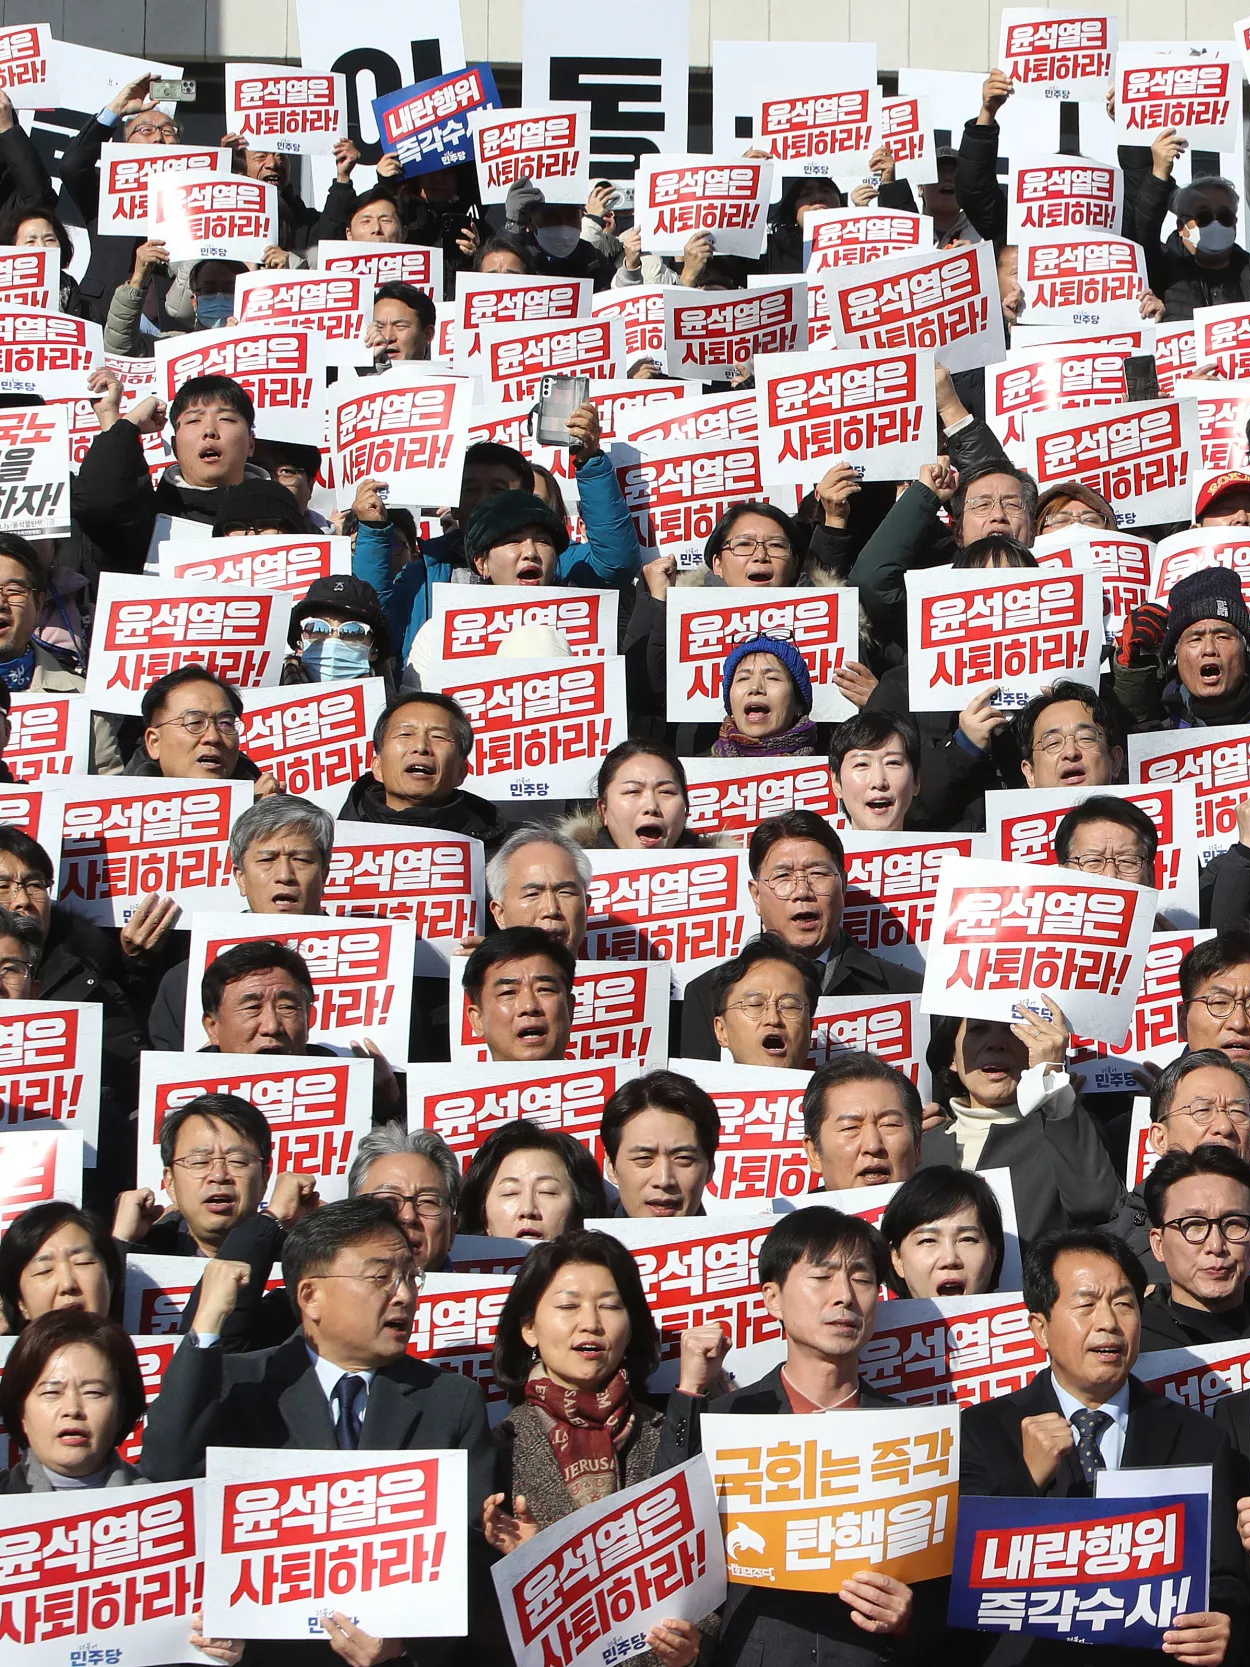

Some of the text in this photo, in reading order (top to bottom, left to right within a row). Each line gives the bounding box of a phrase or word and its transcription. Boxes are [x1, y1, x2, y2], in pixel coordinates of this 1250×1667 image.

[1011, 22, 1102, 53] 윤석열은
[1010, 54, 1110, 83] 사퇴하라!
[1128, 68, 1222, 99] 윤석열은
[240, 80, 329, 107] 윤석열은
[389, 76, 481, 133] 내란행위
[766, 94, 866, 131] 윤석열은
[1128, 101, 1229, 129] 사퇴하라!
[240, 110, 338, 135] 사퇴하라!
[483, 119, 570, 157] 윤석열은
[766, 126, 872, 160] 사퇴하라!
[489, 152, 579, 185] 사퇴하라!
[655, 168, 755, 202] 윤석열은
[1023, 170, 1110, 198] 윤석열은
[654, 203, 759, 233] 사퇴하라!
[1021, 202, 1116, 229] 사퇴하라!
[1034, 244, 1132, 276] 윤석열은
[247, 280, 354, 315] 윤석열은
[470, 287, 574, 324] 윤석열은
[681, 294, 786, 336] 윤석열은
[848, 259, 972, 326] 윤석열은
[1033, 276, 1142, 308] 사퇴하라!
[1073, 312, 1100, 324] 민주당
[174, 337, 301, 391] 윤석열은
[498, 328, 604, 376] 윤석열은
[683, 326, 796, 365] 사퇴하라!
[339, 386, 446, 440] 윤석열은
[776, 362, 908, 419] 윤석열은
[779, 402, 922, 462] 사퇴하라!
[1045, 411, 1172, 475] 윤석열은
[344, 435, 453, 482] 사퇴하라!
[624, 452, 755, 500] 윤석열은
[115, 602, 261, 644] 윤석열은
[931, 582, 1074, 640] 윤석열은
[930, 630, 1088, 687] 사퇴하라!
[510, 782, 548, 796] 민주당
[688, 769, 829, 830] 윤석열은
[63, 791, 222, 848] 윤석열은
[60, 849, 232, 900] 사퇴하라!
[329, 849, 465, 894] 윤석열은
[956, 891, 1126, 940] 윤석열은
[947, 947, 1131, 995] 사퇴하라!
[433, 1077, 604, 1144] 윤석열은
[715, 1428, 953, 1505] 국회는 즉각
[234, 1469, 426, 1543] 윤석열은
[0, 1499, 183, 1582] 윤석열은
[786, 1494, 948, 1571] 탄핵을!
[982, 1514, 1178, 1580] 내란행위
[231, 1532, 446, 1606] 사퇴하라!
[523, 1488, 683, 1630] 윤석열은
[0, 1561, 204, 1645] 사퇴하라!
[541, 1531, 706, 1667] 사퇴하라!
[977, 1576, 1192, 1632] 즉각수사!
[70, 1648, 122, 1666] 민주당
[602, 1634, 646, 1666] 민주당
